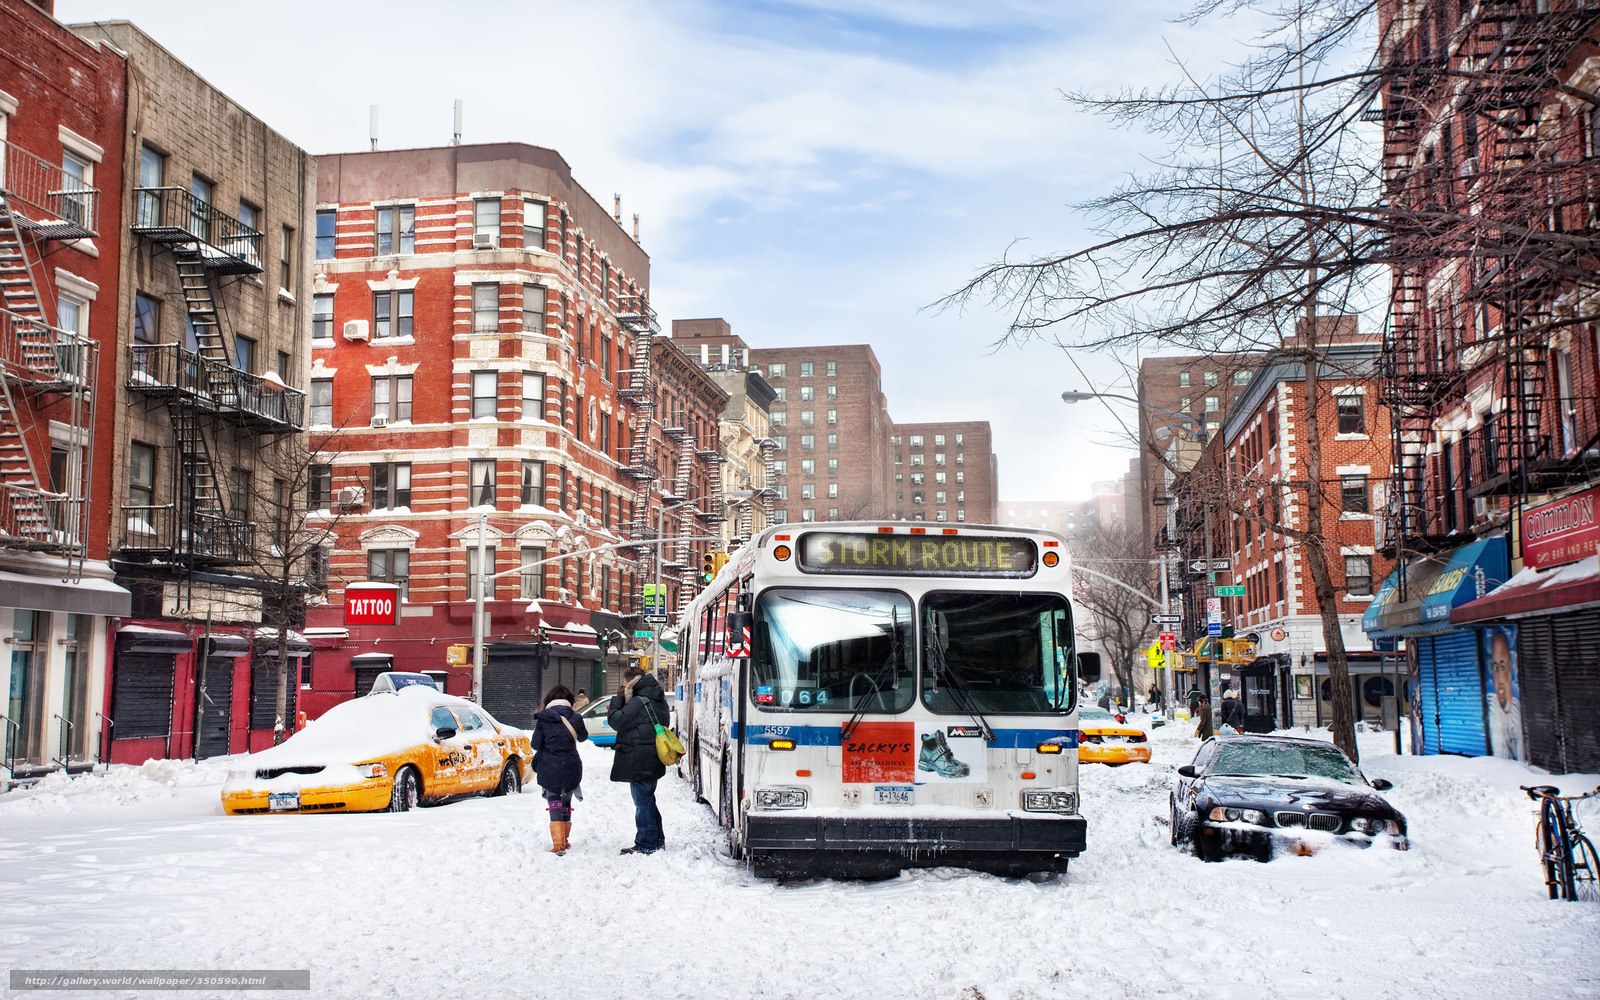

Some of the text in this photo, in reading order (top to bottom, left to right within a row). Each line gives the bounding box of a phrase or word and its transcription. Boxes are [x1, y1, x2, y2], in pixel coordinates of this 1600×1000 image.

[816, 536, 1012, 569] STORM ROUTE
[1552, 548, 1564, 560] BAR
[1567, 543, 1581, 556] AND
[1212, 561, 1226, 569] WAY
[349, 598, 392, 615] TATTOO
[764, 726, 791, 736] 5597
[846, 742, 911, 754] ZACKY'S
